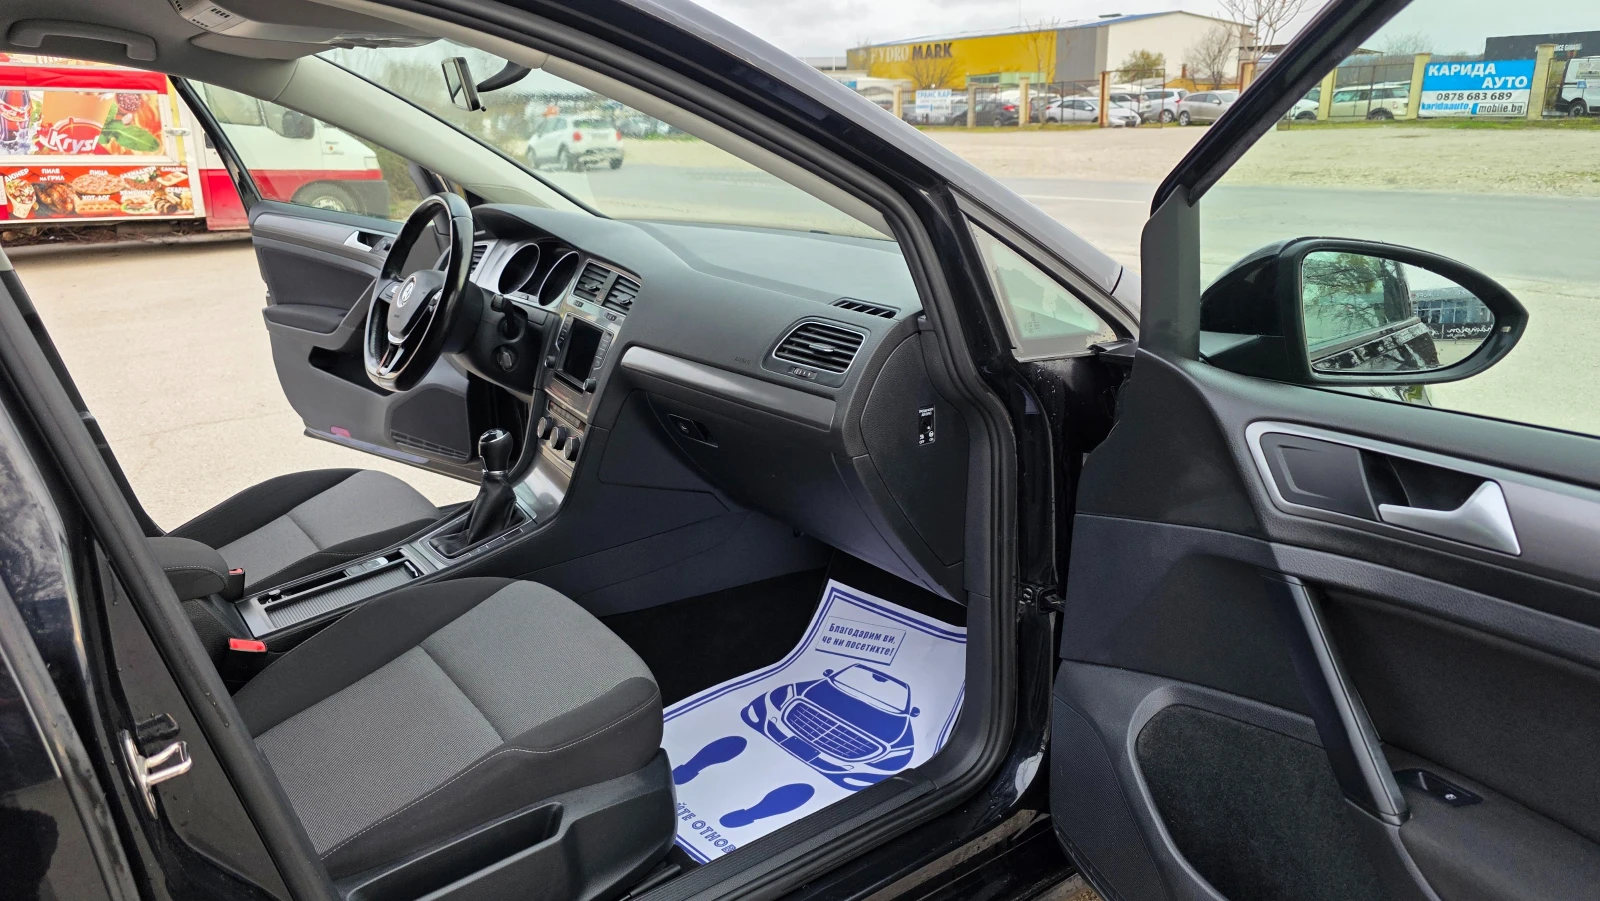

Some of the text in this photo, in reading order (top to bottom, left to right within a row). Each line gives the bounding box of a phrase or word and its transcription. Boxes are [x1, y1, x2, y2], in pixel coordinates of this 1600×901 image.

[913, 42, 953, 60] MARK
[1428, 63, 1496, 78] КАРИДА
[1481, 76, 1528, 89] АУТО
[1436, 92, 1512, 101] 0878 683 689
[1478, 104, 1523, 114] mobile.bg
[829, 623, 896, 645] Благодарим ви,
[822, 635, 895, 656] че ни посетихте!
